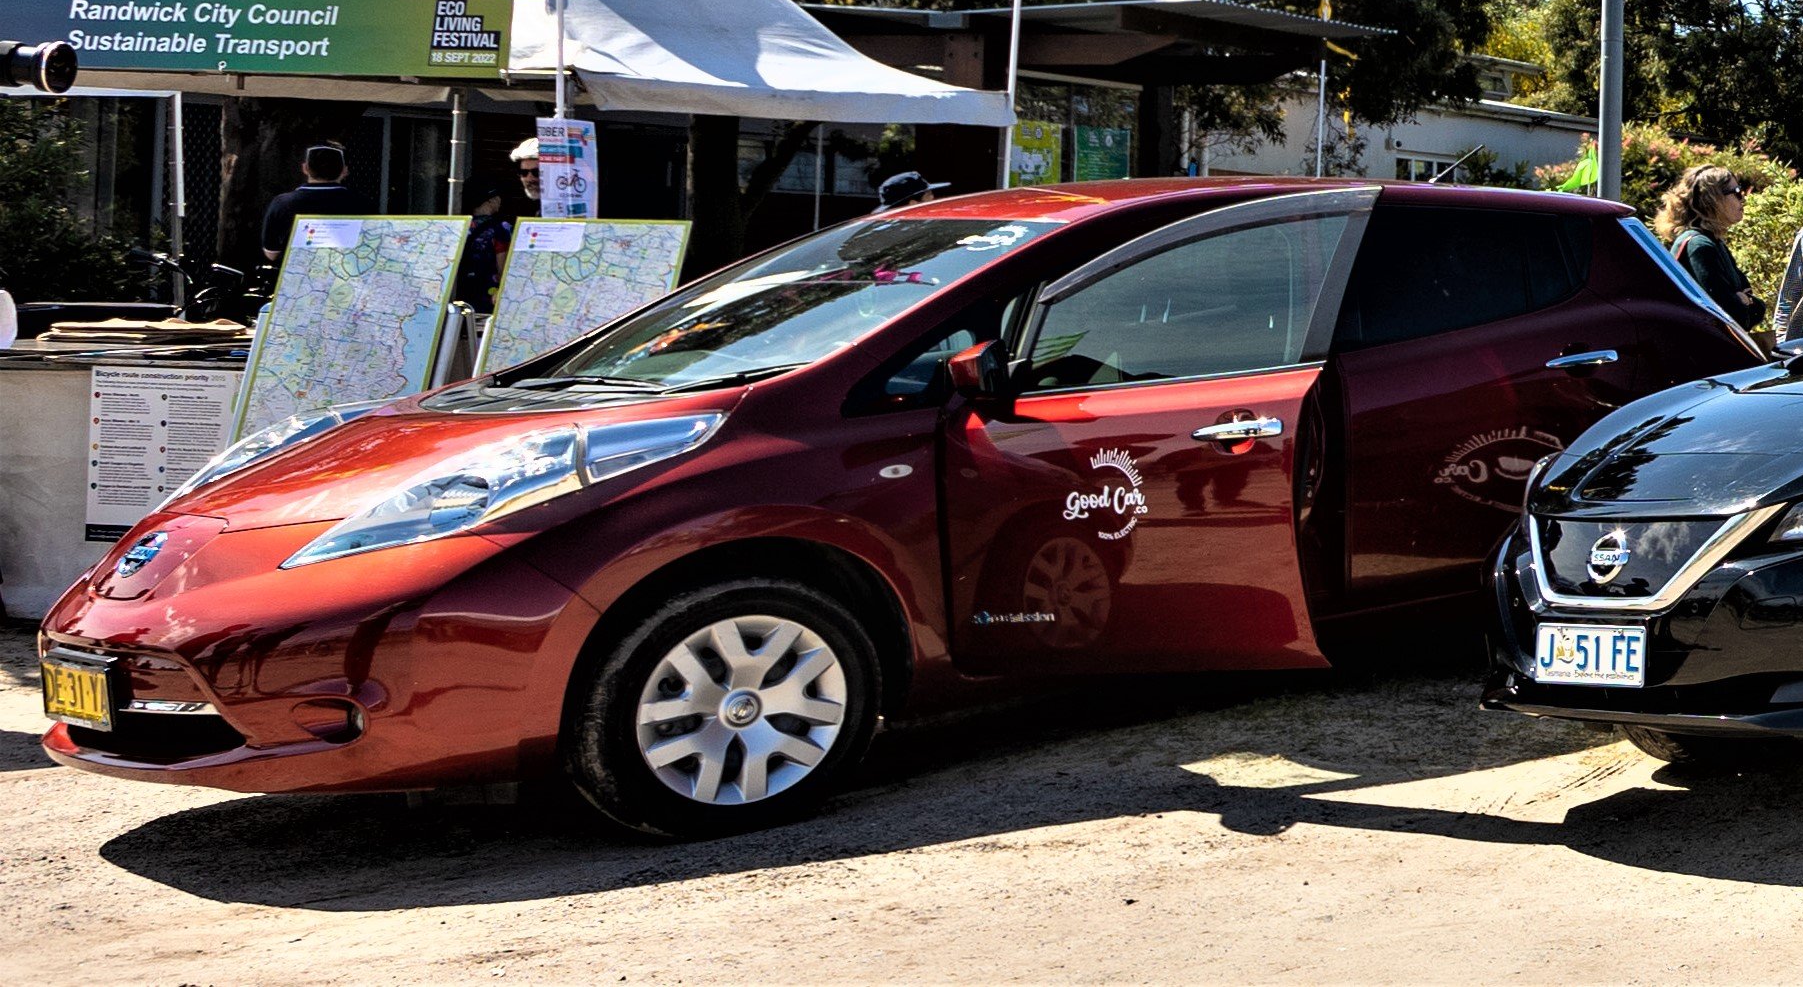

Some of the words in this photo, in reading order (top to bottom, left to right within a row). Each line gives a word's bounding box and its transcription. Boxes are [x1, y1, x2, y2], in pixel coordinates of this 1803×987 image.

[69, 0, 188, 23] Randwick
[193, 2, 240, 28] City
[247, 4, 339, 26] Council
[437, 0, 465, 16] ECO
[435, 16, 481, 31] LIVING
[67, 29, 207, 54] Sustainable
[215, 33, 330, 60] Transport
[432, 32, 498, 47] FESTIVAL
[431, 52, 443, 63] 18
[444, 52, 470, 63] SEPT
[471, 53, 496, 64] 2022
[1063, 485, 1111, 520] Good
[1113, 486, 1145, 514] Car
[1097, 530, 1114, 541] 100%
[1113, 515, 1138, 540] ELECTRIC
[1612, 635, 1641, 672] FE
